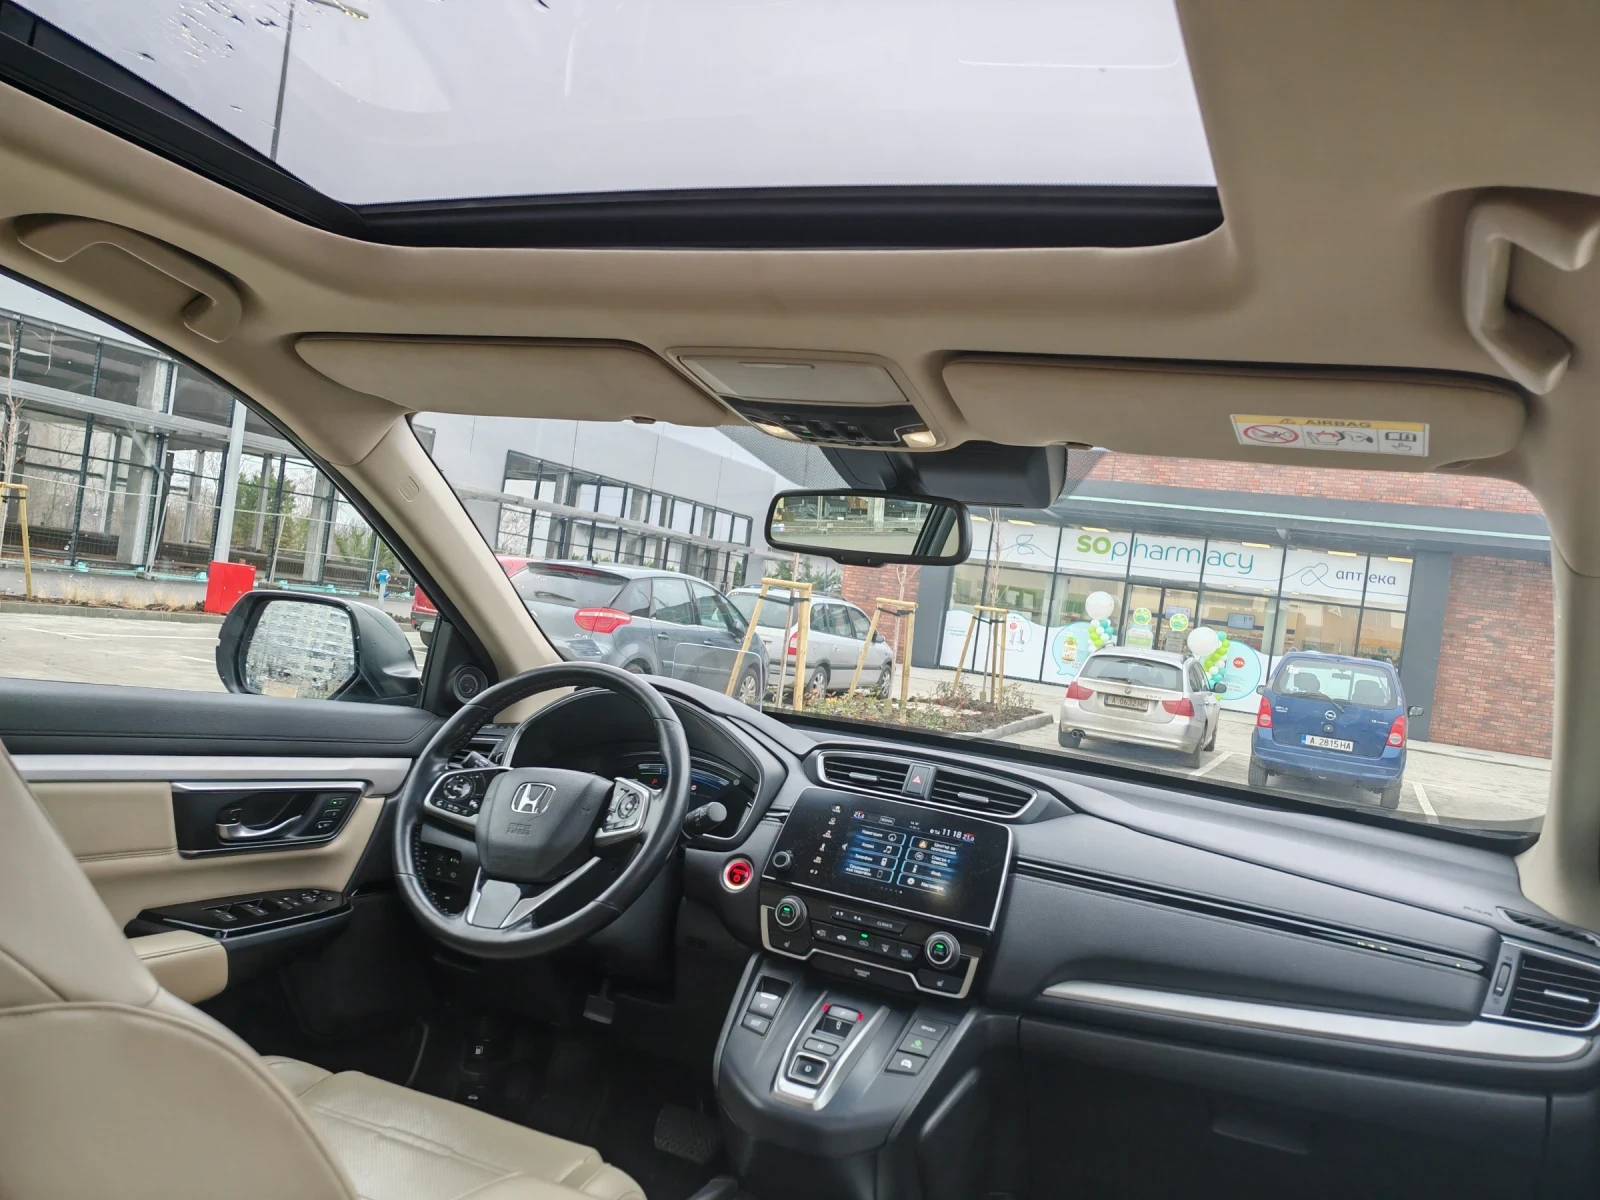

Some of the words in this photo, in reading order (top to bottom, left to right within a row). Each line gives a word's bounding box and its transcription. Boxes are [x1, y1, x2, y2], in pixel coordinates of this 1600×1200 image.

[1305, 419, 1372, 428] AIRBAG
[1076, 534, 1254, 575] sopharmacy
[1335, 569, 1396, 586] аптека
[1318, 738, 1339, 748] 2815
